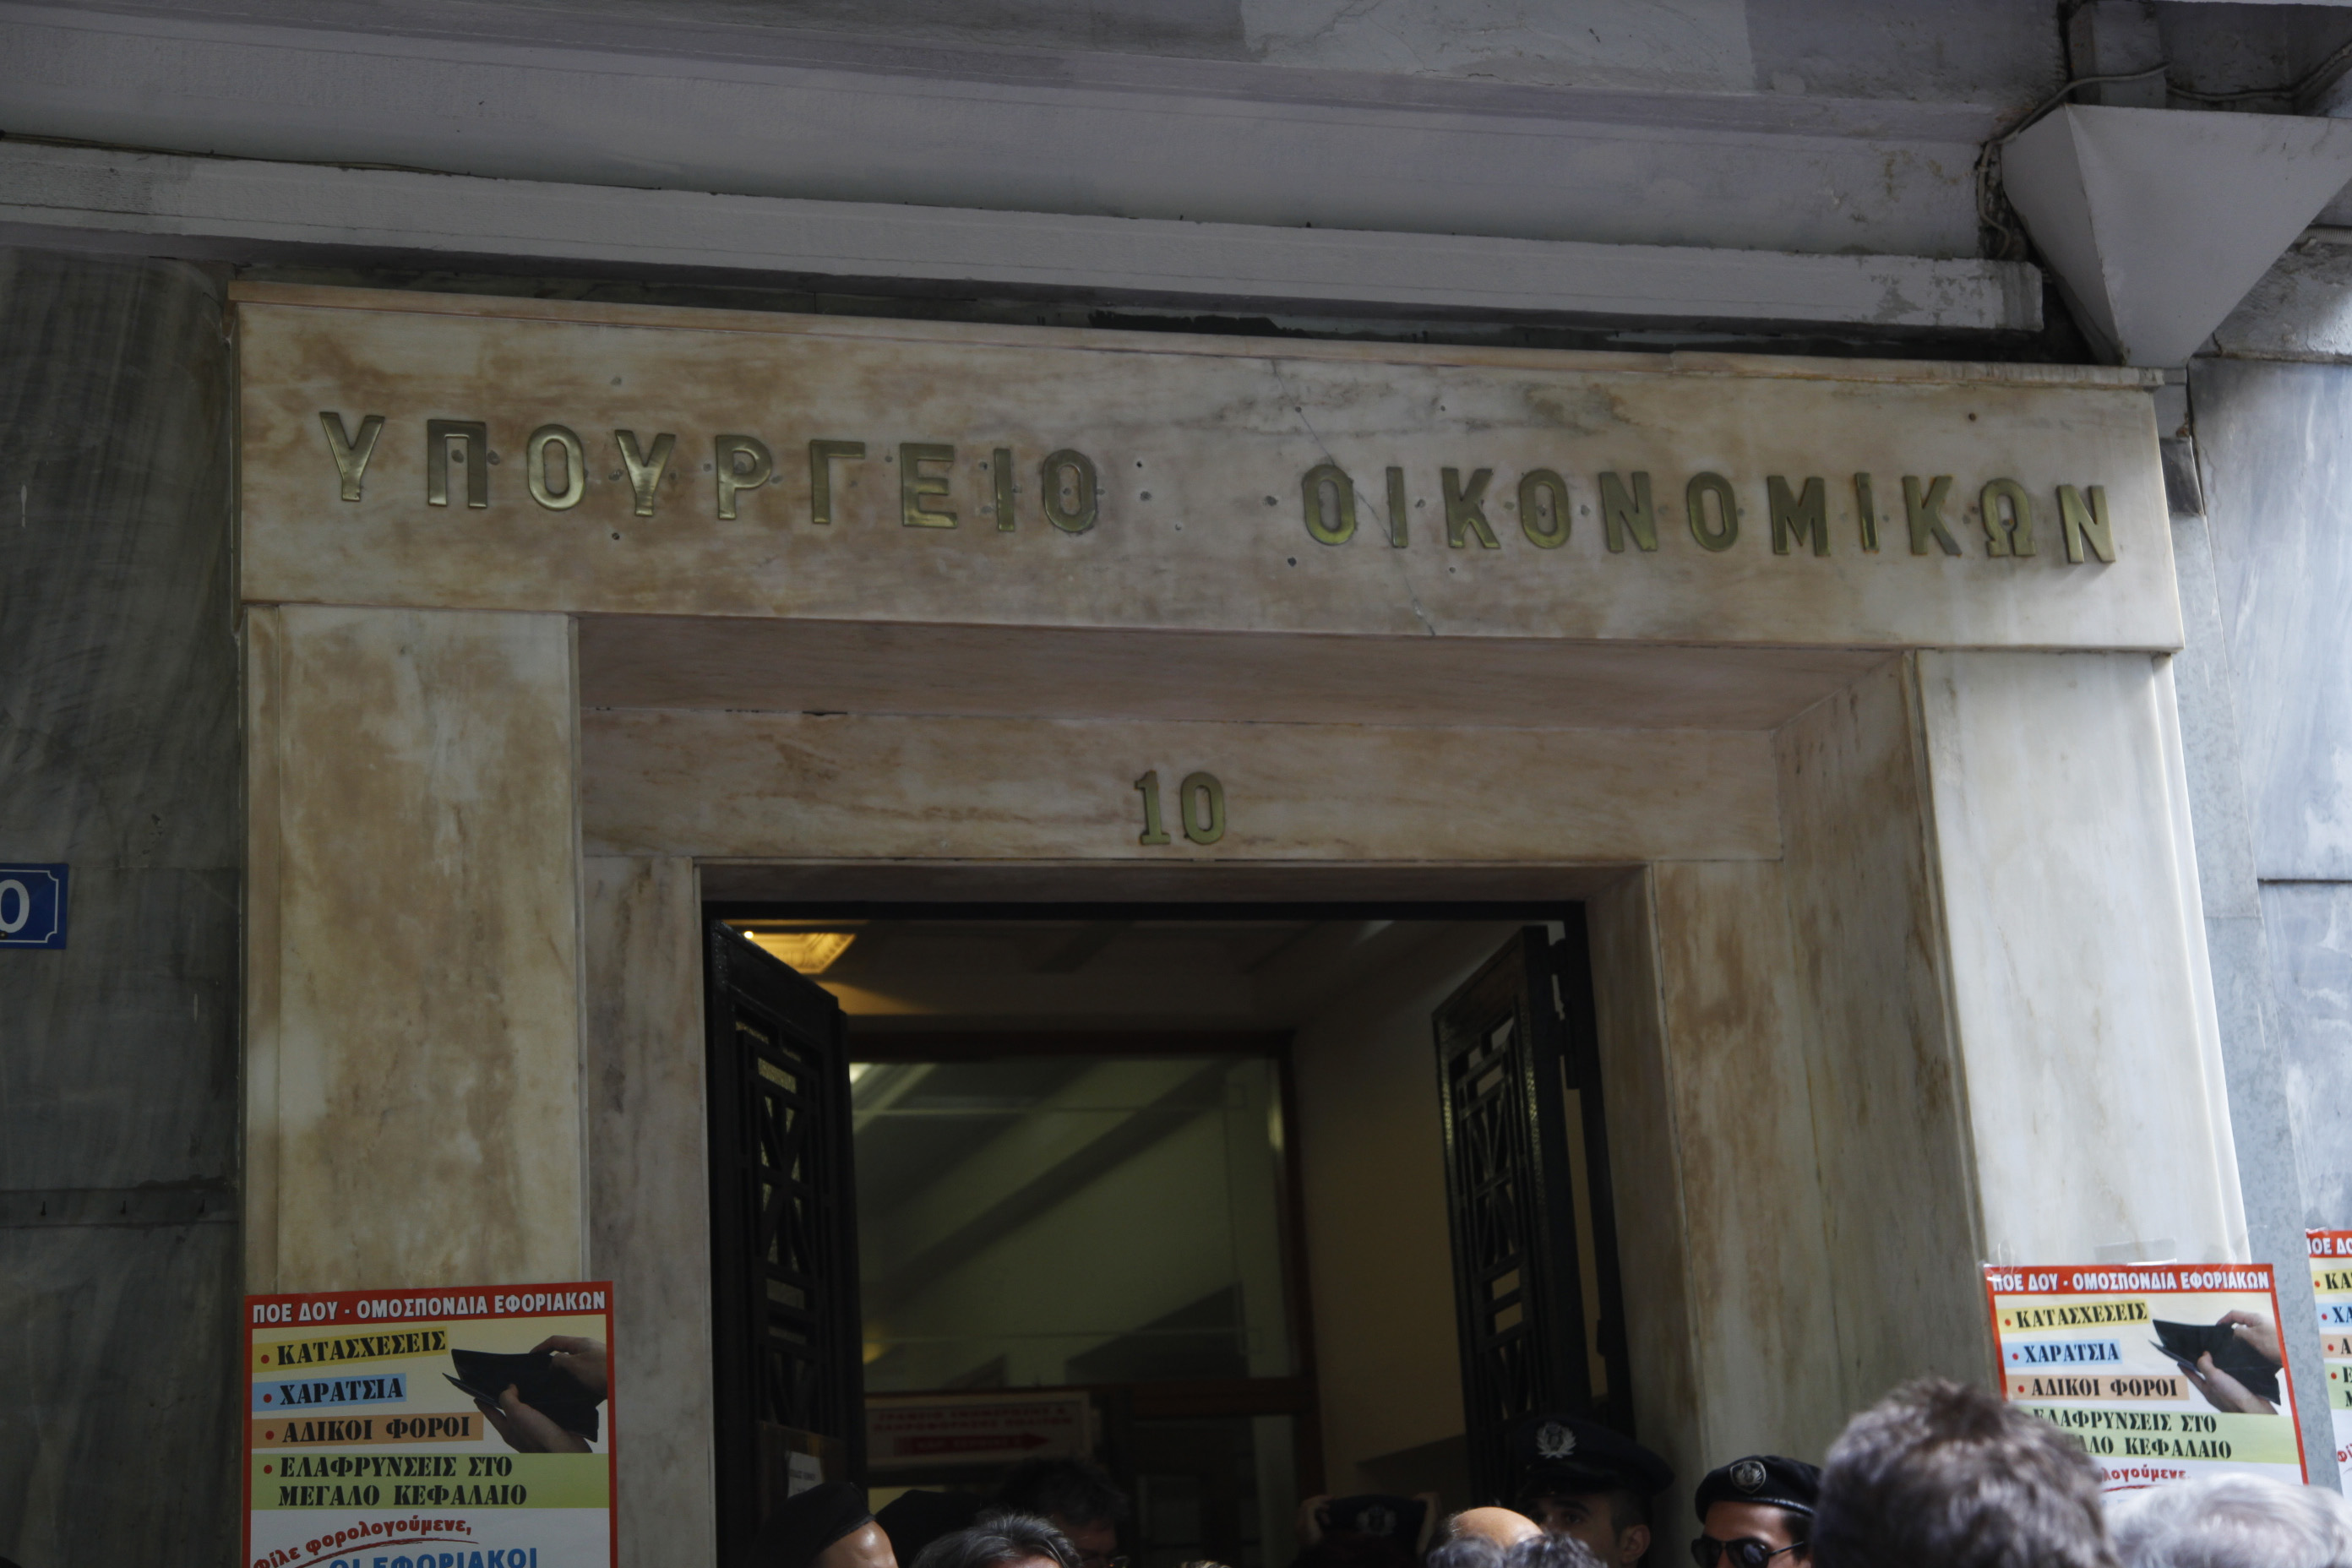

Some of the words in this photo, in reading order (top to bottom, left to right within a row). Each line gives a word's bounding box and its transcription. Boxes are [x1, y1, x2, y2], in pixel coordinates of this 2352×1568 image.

[318, 411, 1097, 534] ΥΠΟΥΡΓΕΙΟ
[1302, 464, 2116, 564] ΟΙΚΟΝΟΜΙΚΩΝ
[1134, 770, 1226, 846] 10
[1992, 1273, 2024, 1292] ΠΟΕ
[2028, 1273, 2058, 1292] ΔΟΥ
[2072, 1271, 2177, 1291] ΟΜΟΣΠΟΝΔΙΑ
[2180, 1271, 2269, 1290] ΕΦΟΡΙΑΚΩΝ
[253, 1304, 292, 1323] ΠΟΕ
[299, 1301, 339, 1321] ΔΟΥ
[357, 1295, 488, 1320] ΟΜΟΣΠΟΝΔΙΑ
[494, 1291, 605, 1314] ΕΦΟΡΙΑΚΩΝ
[2016, 1302, 2148, 1329] ΚΑΤΑΣΧΕΣΕΙΣ
[277, 1331, 446, 1366] ΚΑΤΑΣΧΕΣΕΙΣ
[2023, 1342, 2120, 1364] ΧΑΡΑΤΣΙΑ
[280, 1377, 404, 1406] ΧΑΡΑΤΣΙΑ
[2031, 1378, 2101, 1396] ΑΔΙΚΟΙ
[2110, 1379, 2178, 1397] ΦΟΡΟΙ
[282, 1419, 373, 1443] ΑΔΙΚΟΙ
[385, 1416, 471, 1440] ΦΟΡΟΙ
[2180, 1414, 2217, 1433] ΣΤΟ
[2075, 1435, 2114, 1454] ΑΛΟ
[2125, 1437, 2232, 1459] ΚΕΦΑΛΑΙΟ
[280, 1456, 457, 1478] ΕΛΑΦΡΥΝΣΕΙΣ
[468, 1456, 513, 1478] ΣΤΟ
[278, 1484, 380, 1506] ΜΕΓΑΛΟ
[393, 1484, 527, 1506] ΚΕΦΑΛΑΙΟ
[305, 1515, 472, 1556] φορολογούμενε,
